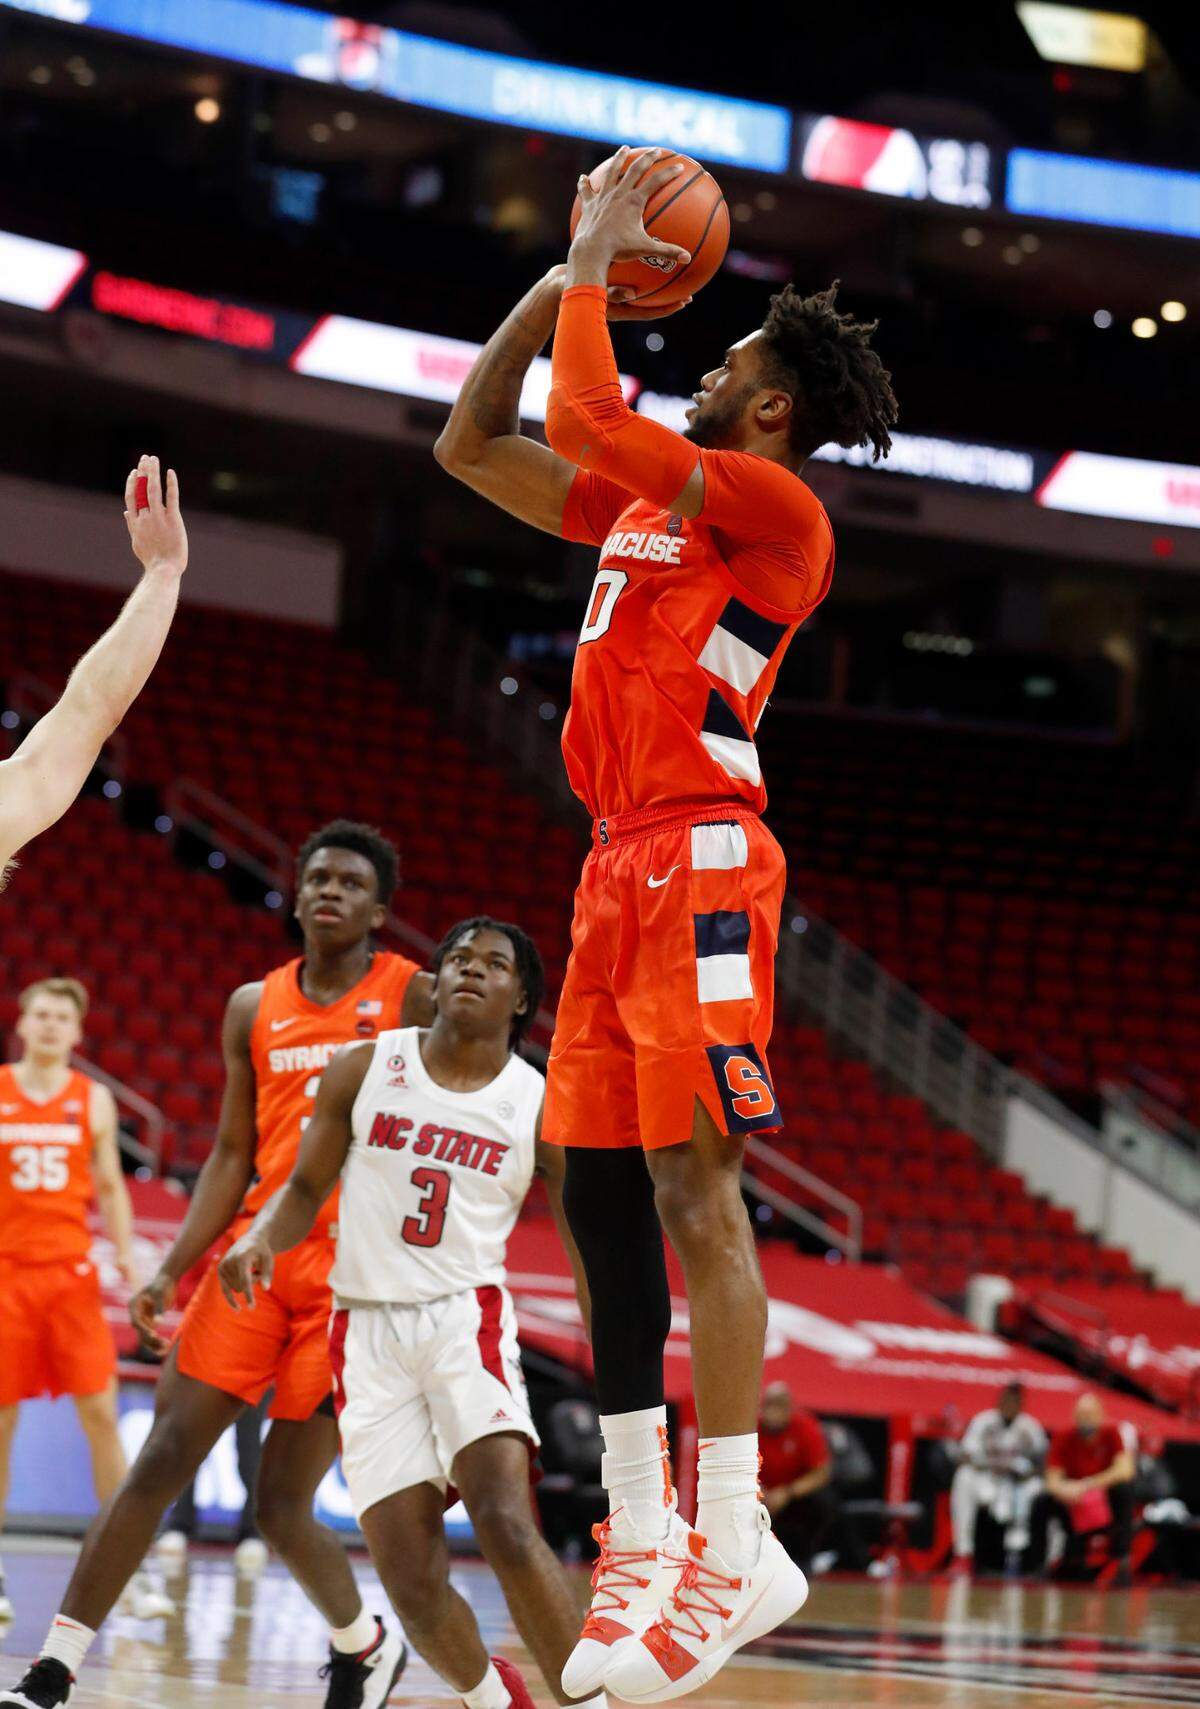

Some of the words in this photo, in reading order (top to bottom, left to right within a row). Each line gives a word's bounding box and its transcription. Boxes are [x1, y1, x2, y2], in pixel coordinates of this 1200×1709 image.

[614, 90, 747, 157] LOCAL
[600, 531, 688, 565] ACUSE
[268, 1042, 340, 1073] SYRAC
[724, 1055, 776, 1120] S
[9, 1145, 69, 1192] 35
[367, 1111, 415, 1151] NC
[412, 1122, 511, 1177] STATE
[401, 1166, 452, 1249] 3
